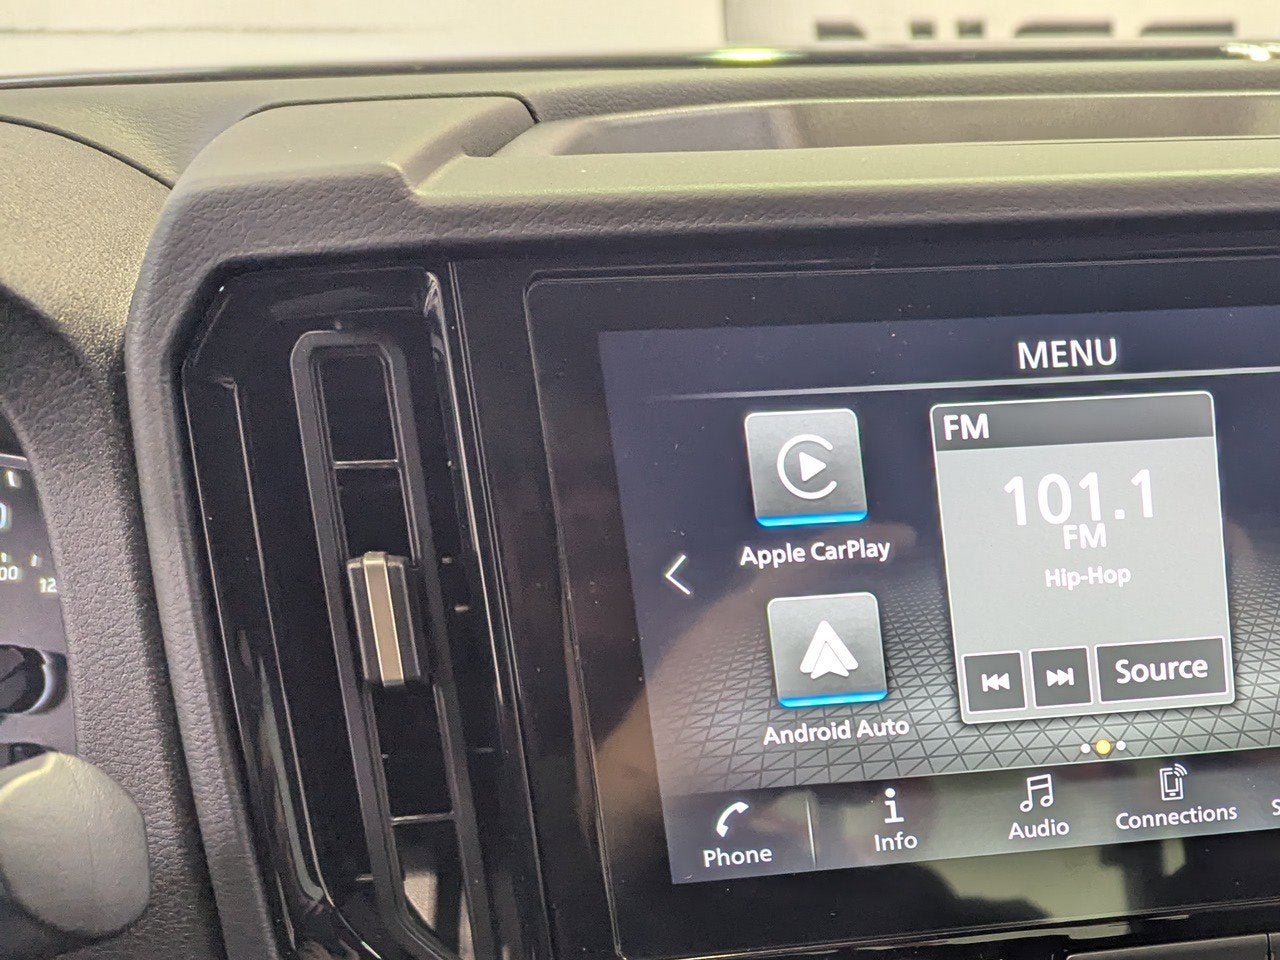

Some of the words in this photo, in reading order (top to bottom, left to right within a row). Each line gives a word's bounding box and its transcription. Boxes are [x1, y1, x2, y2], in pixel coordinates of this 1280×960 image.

[1018, 338, 1118, 370] MENU
[943, 413, 990, 441] FM
[1004, 468, 1155, 526] 101.1
[1063, 524, 1107, 551] FM
[740, 543, 806, 568] Apple
[811, 538, 890, 564] CarPlay
[1045, 565, 1131, 591] Hip-Hop
[1115, 659, 1209, 685] Source
[763, 721, 851, 745] Android
[856, 718, 910, 739] Auto
[1008, 820, 1069, 840] Audio
[1115, 805, 1238, 831] Connections
[874, 832, 918, 852] Info
[703, 847, 772, 867] Phone
